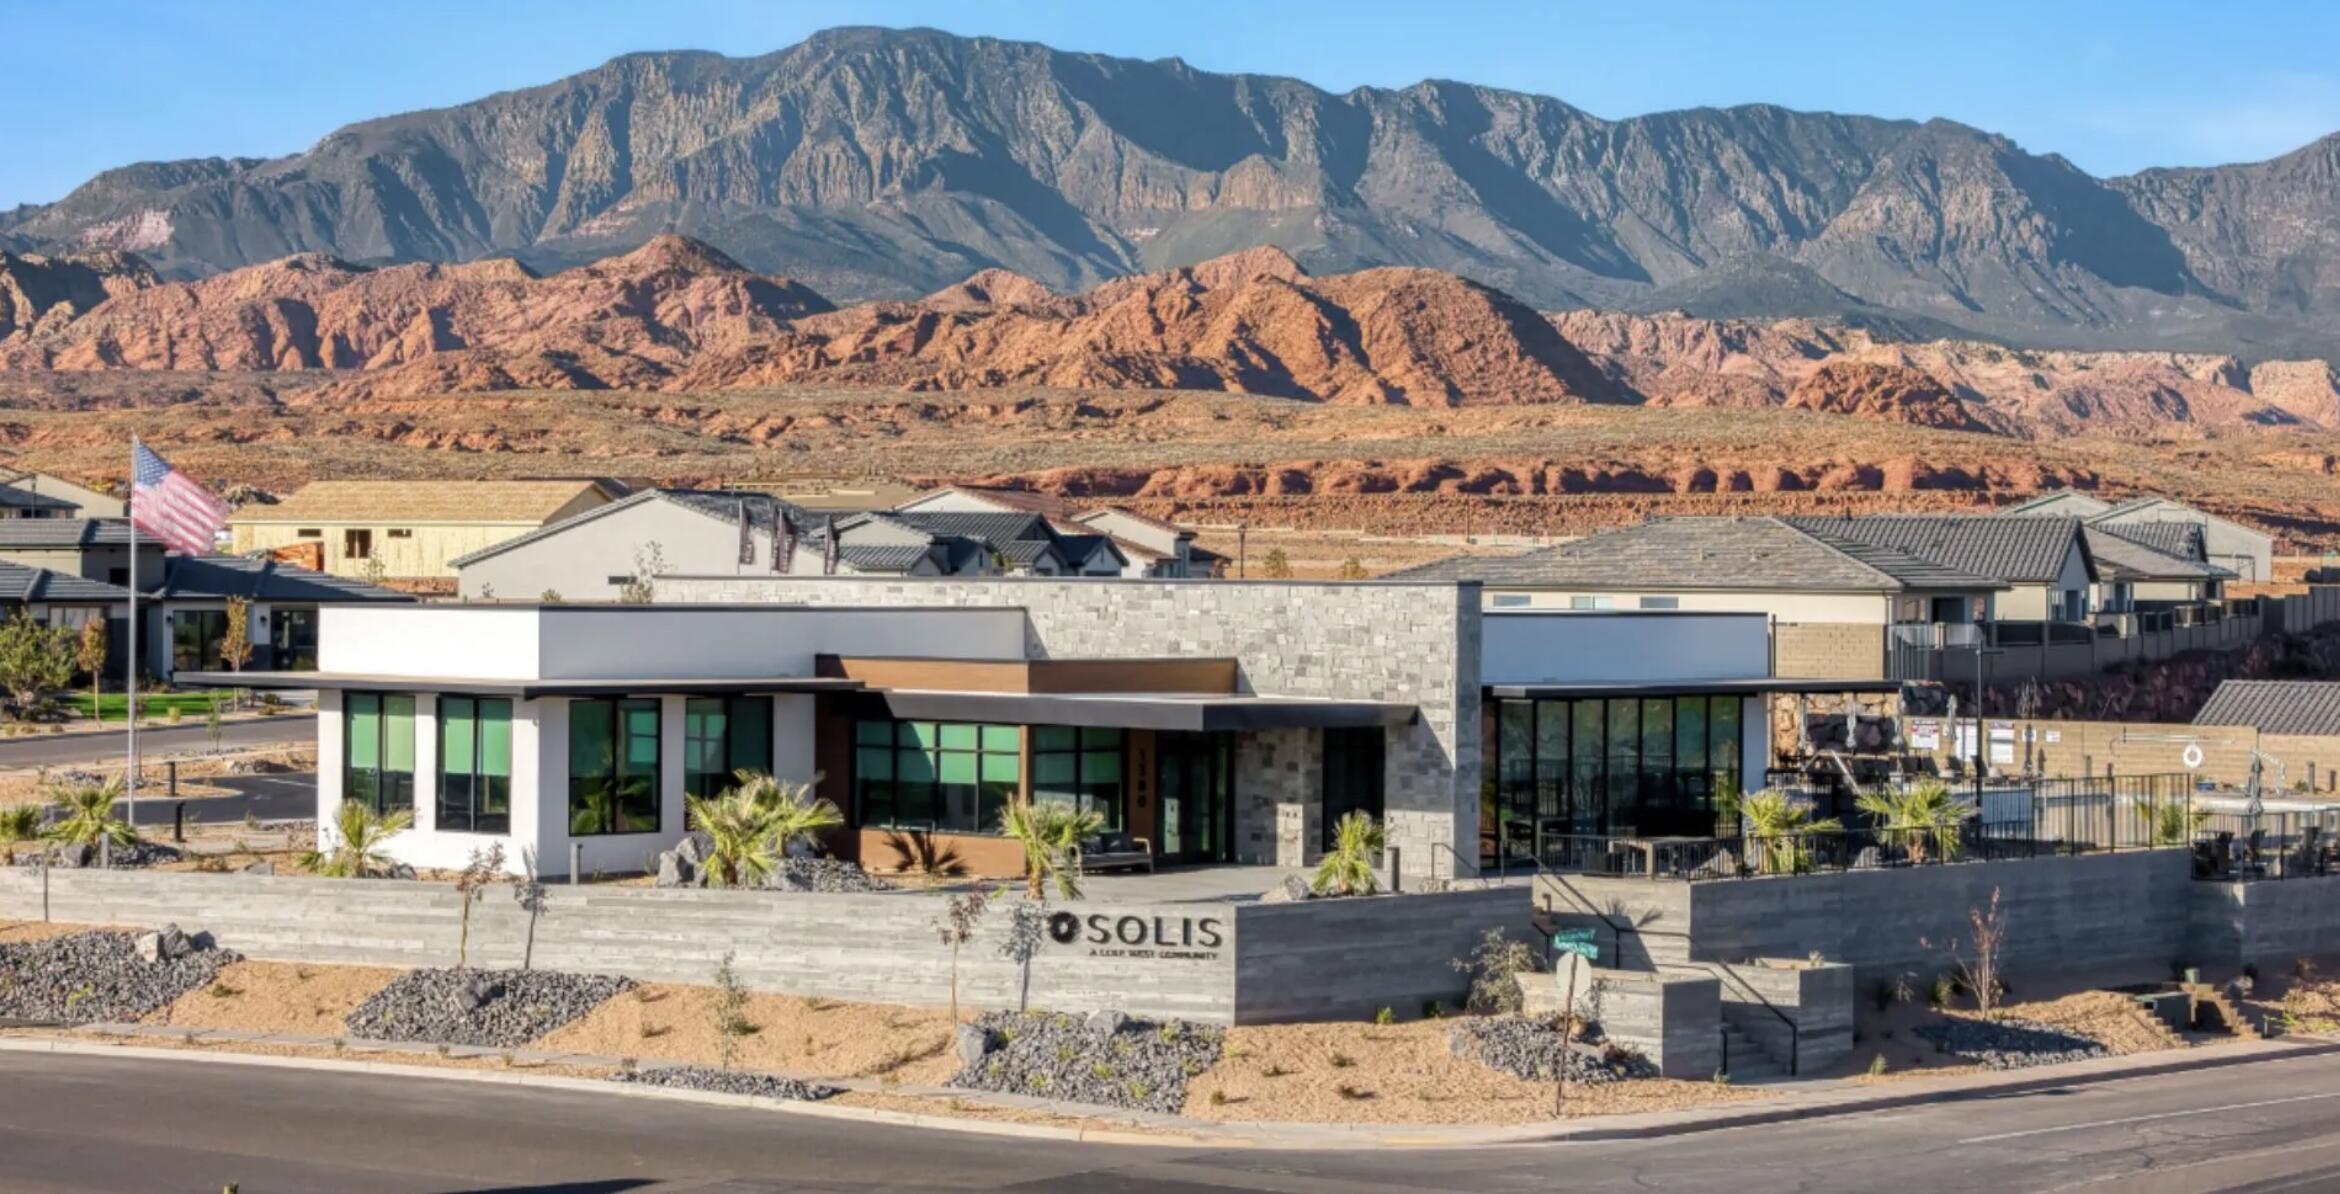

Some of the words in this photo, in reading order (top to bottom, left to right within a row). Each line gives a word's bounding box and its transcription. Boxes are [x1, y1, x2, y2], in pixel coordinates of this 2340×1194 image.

[1087, 914, 1222, 947] SOLIS
[1089, 948, 1098, 957] A
[1128, 949, 1155, 959] WEST
[1158, 950, 1219, 960] COMMUNITY
